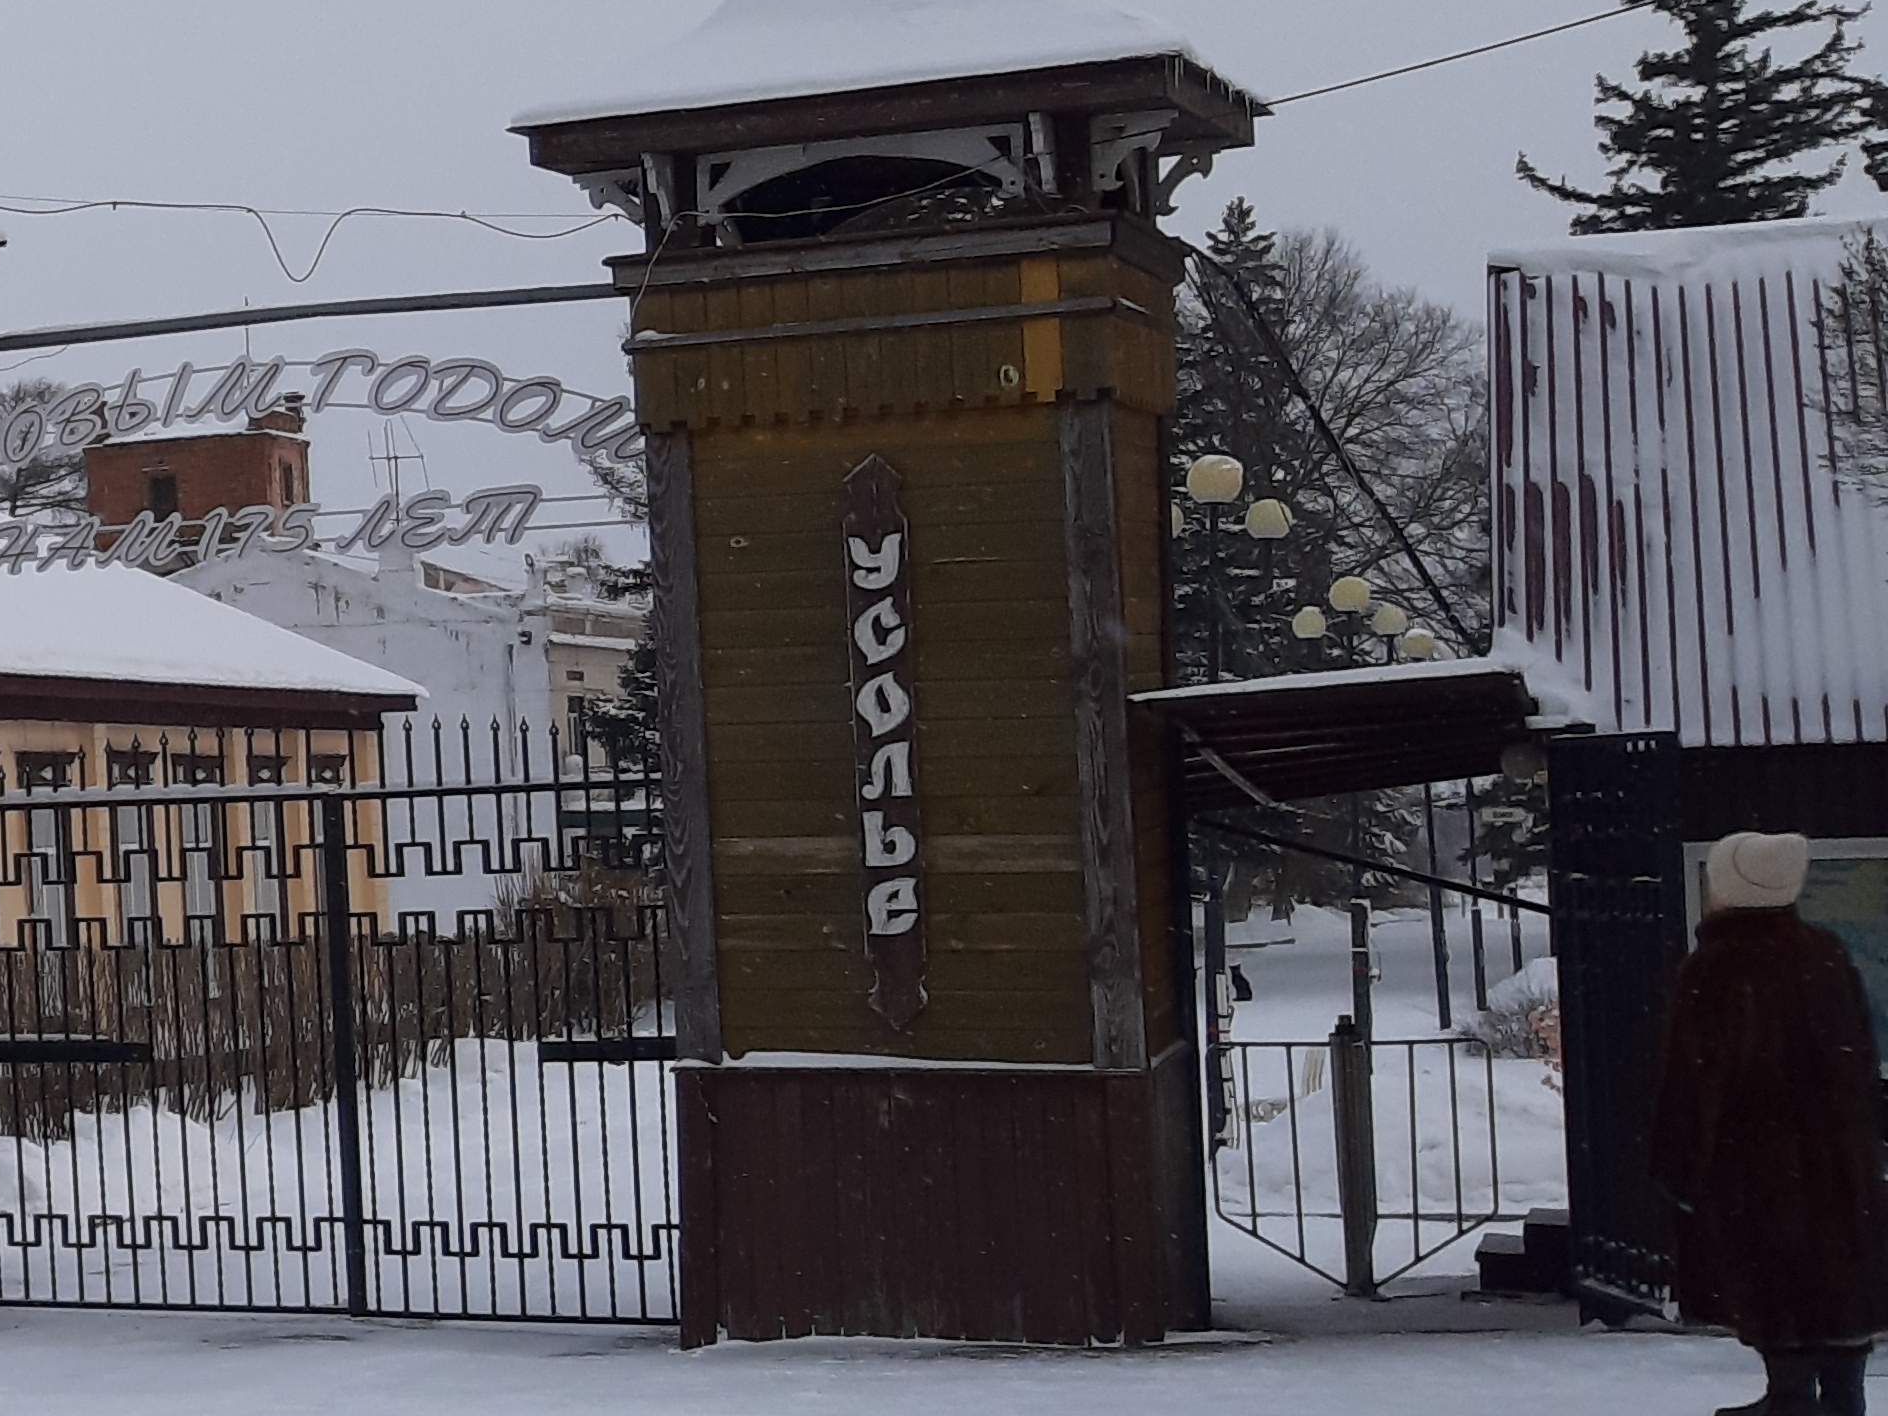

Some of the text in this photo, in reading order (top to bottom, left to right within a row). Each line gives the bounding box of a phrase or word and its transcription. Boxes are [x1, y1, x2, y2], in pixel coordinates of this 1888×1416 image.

[310, 347, 647, 464] ГОДОМ
[196, 502, 322, 562] 175
[334, 484, 543, 554] ЛЕТ
[847, 532, 920, 936] УСОЛЬЕ
